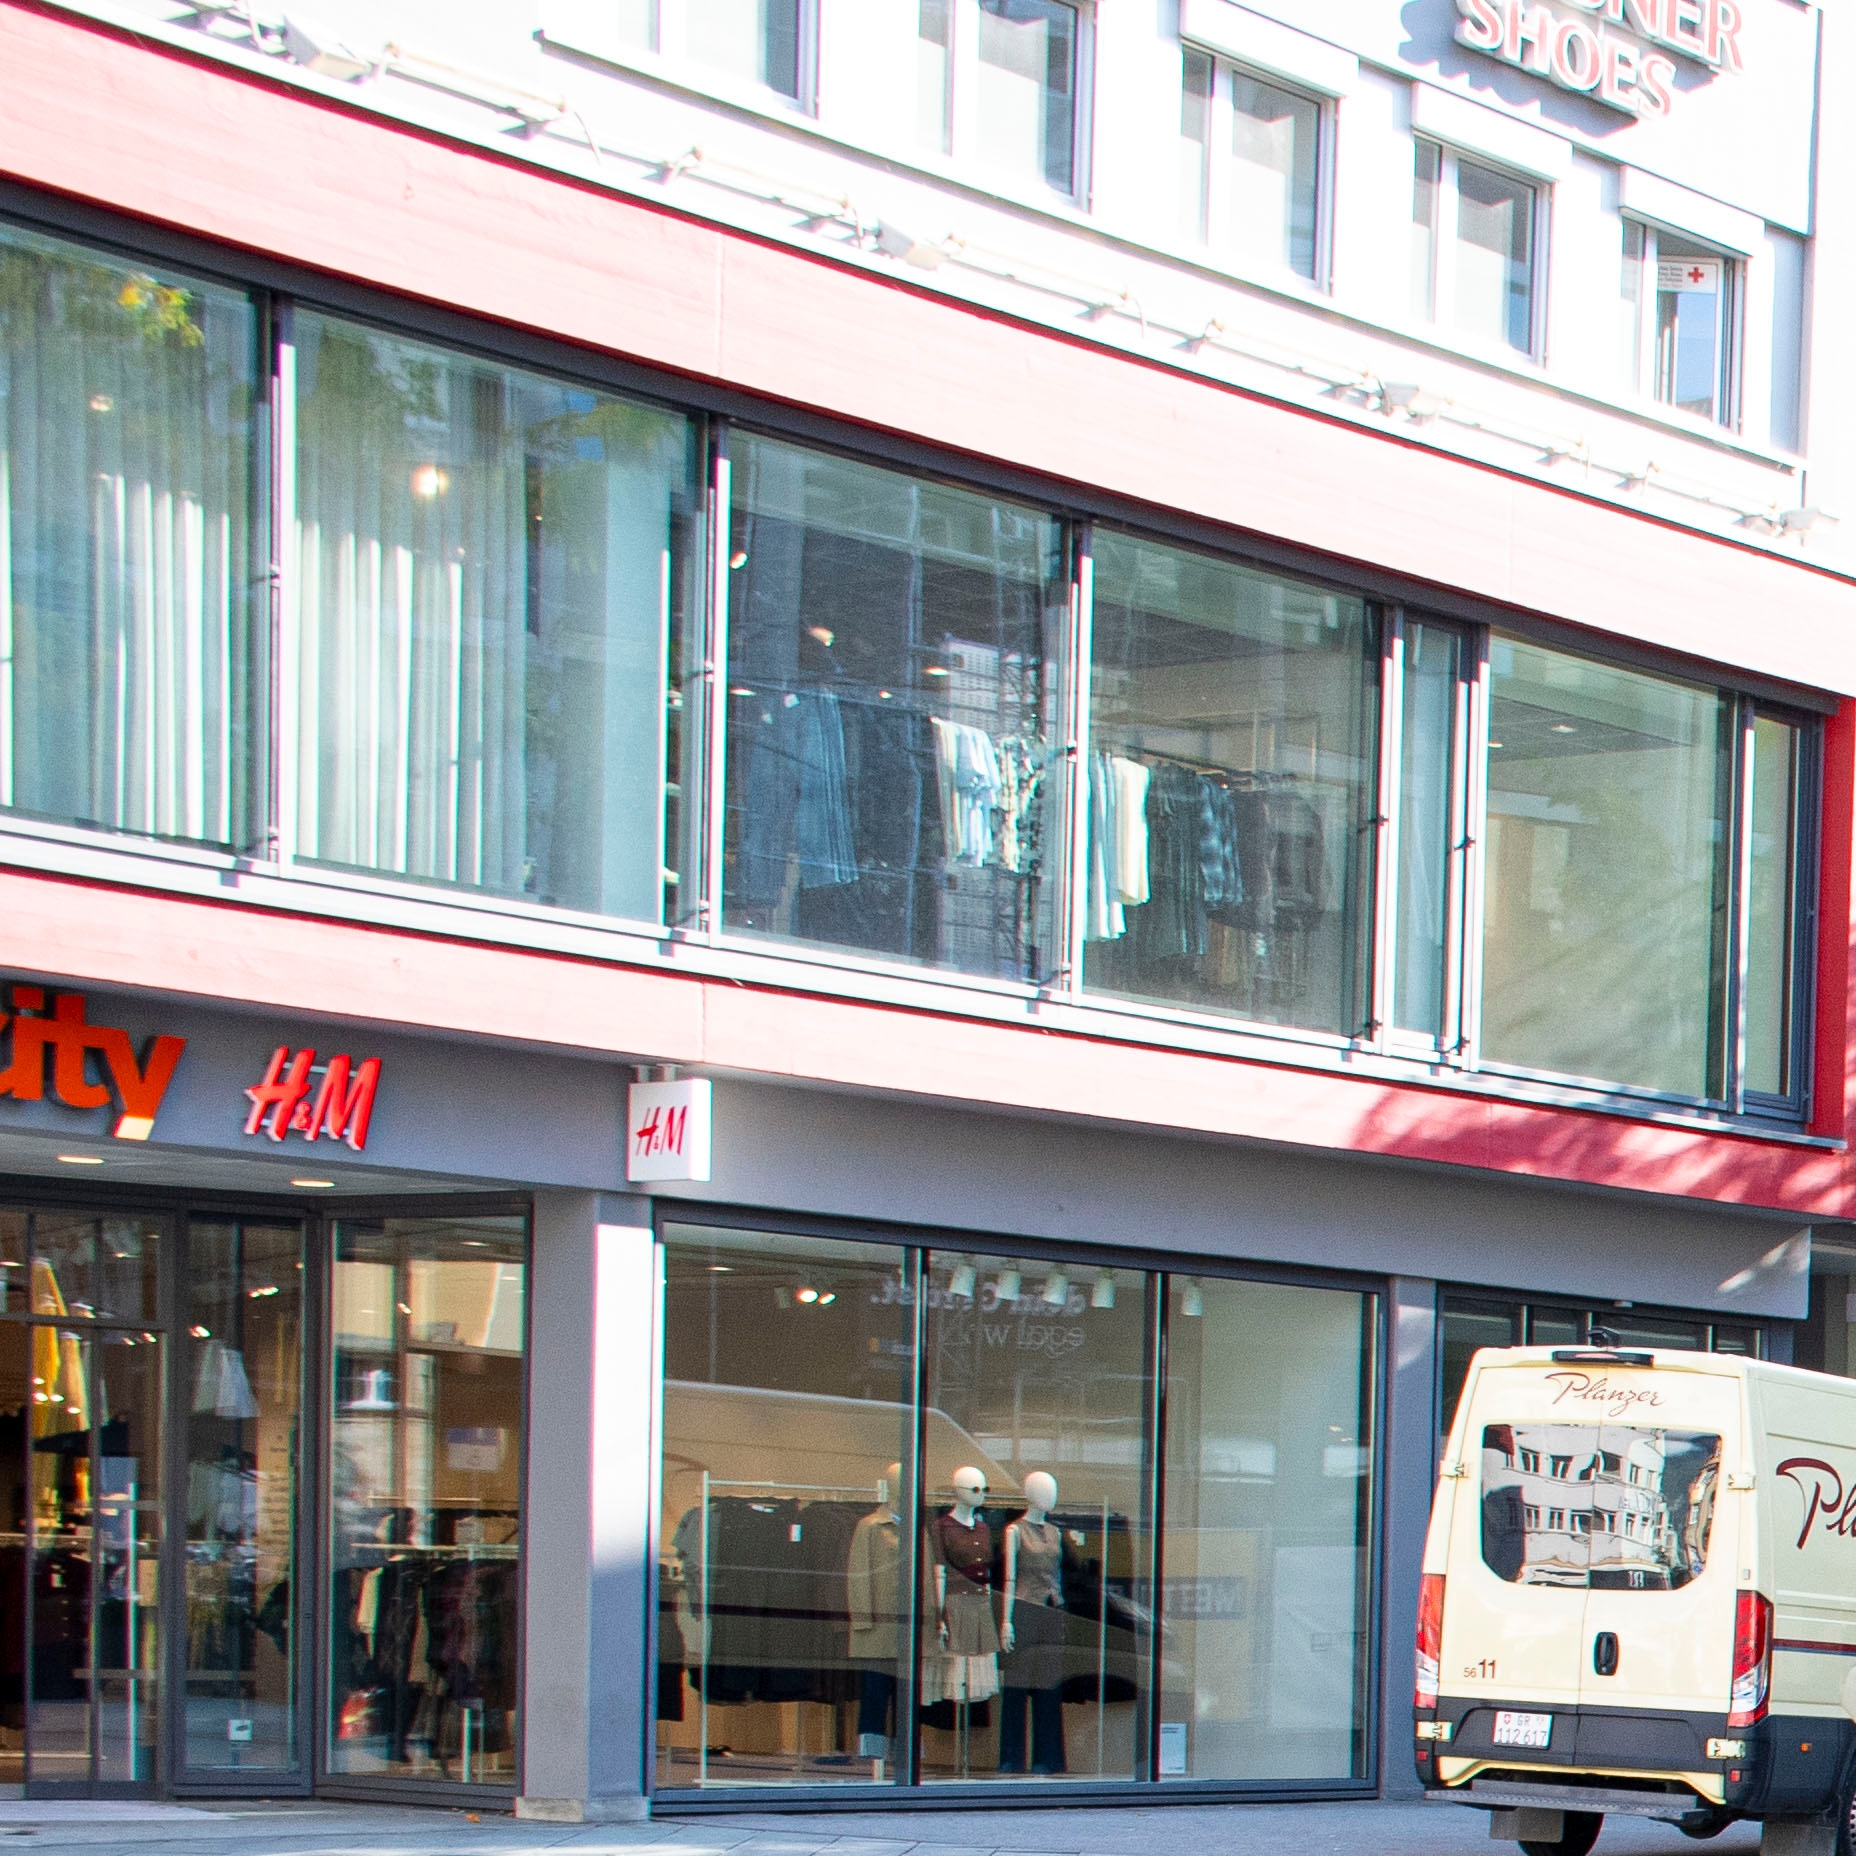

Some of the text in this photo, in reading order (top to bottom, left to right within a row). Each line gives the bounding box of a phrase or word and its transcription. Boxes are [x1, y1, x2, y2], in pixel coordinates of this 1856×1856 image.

[243, 1045, 382, 1151] H&M
[635, 1104, 688, 1156] H&M
[1544, 1371, 1665, 1418] Planzer
[1517, 1714, 1531, 1726] GR
